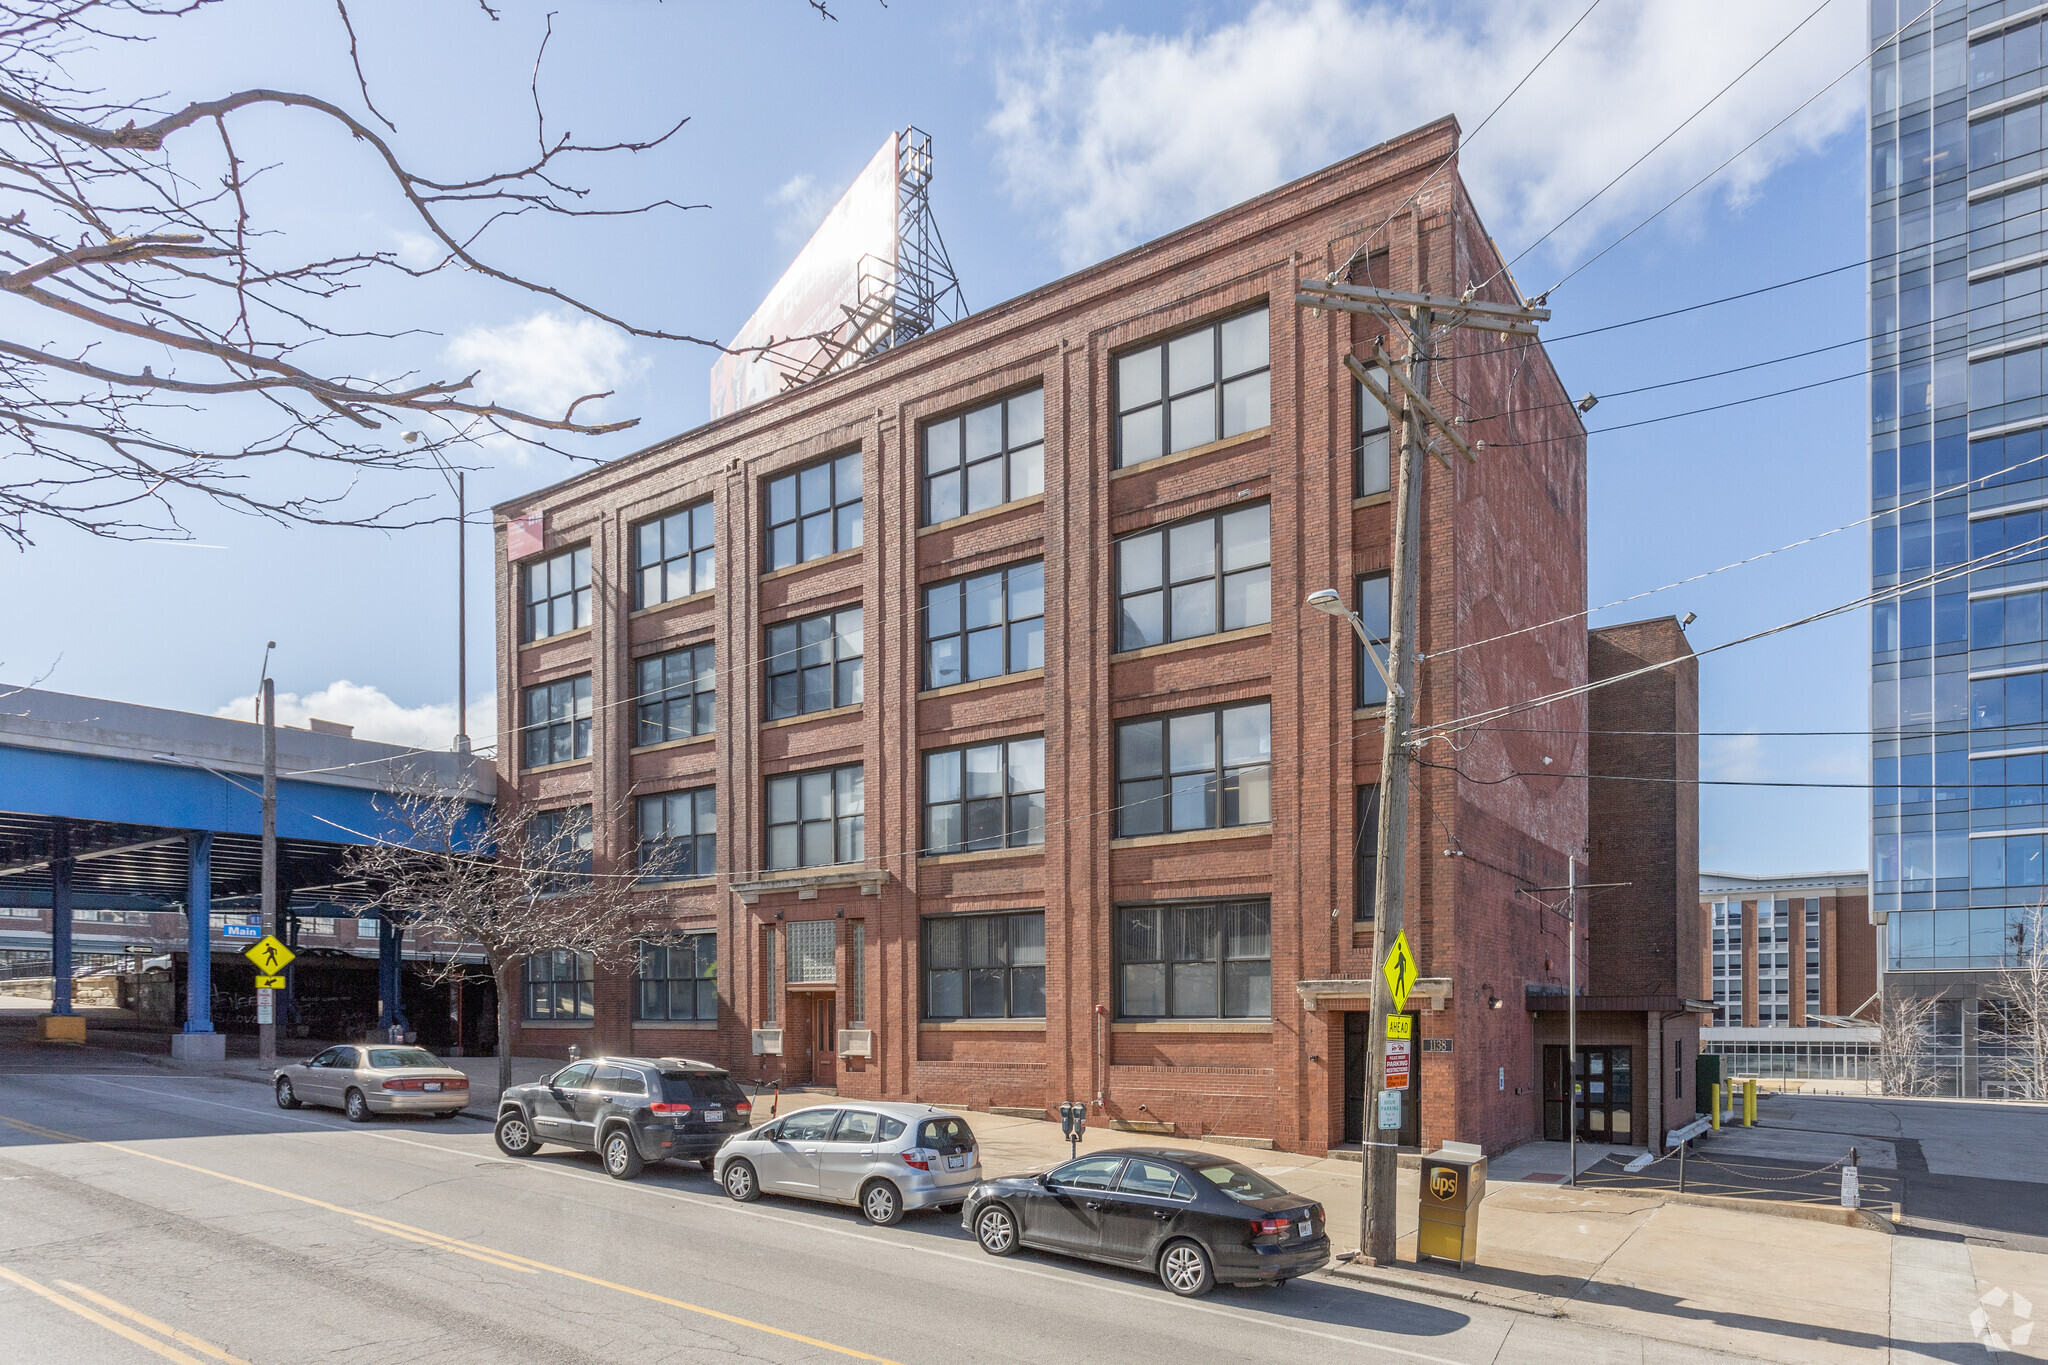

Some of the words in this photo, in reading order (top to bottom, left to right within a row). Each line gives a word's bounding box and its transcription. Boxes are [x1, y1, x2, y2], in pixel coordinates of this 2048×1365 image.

[228, 927, 257, 936] Main
[1389, 1021, 1409, 1034] AHEAD
[1429, 1040, 1447, 1051] 1138
[1432, 1177, 1456, 1196] ups
